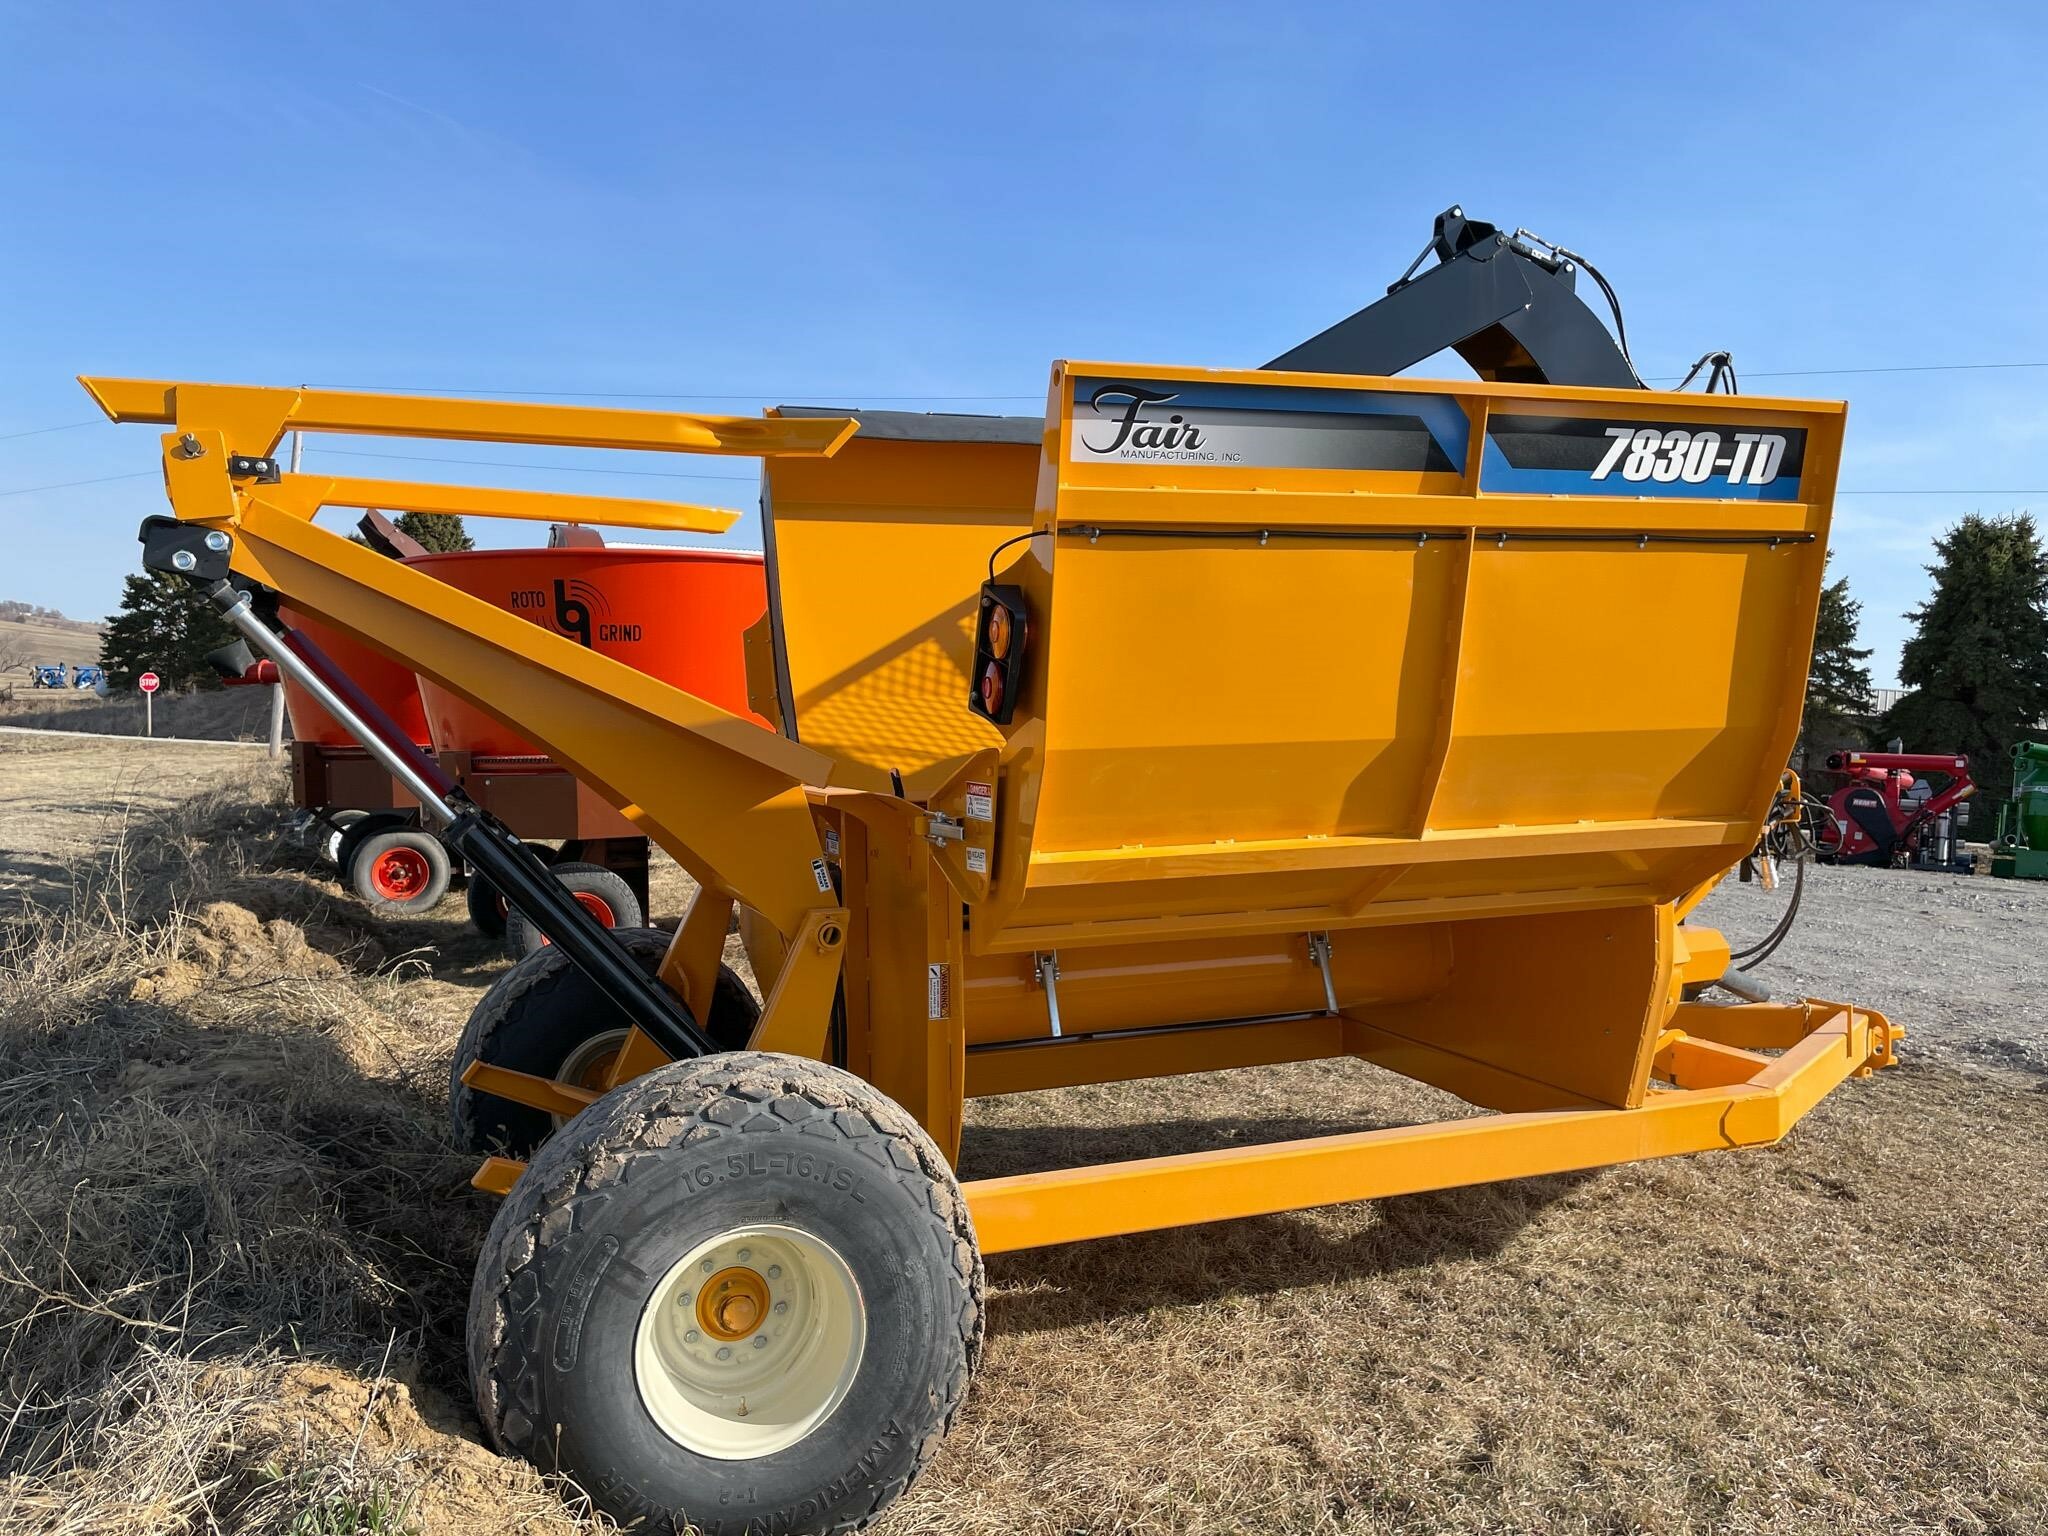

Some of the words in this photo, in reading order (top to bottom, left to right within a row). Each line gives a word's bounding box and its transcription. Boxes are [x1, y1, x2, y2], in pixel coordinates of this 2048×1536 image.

[1081, 384, 1207, 454] Fair
[1120, 450, 1218, 461] MANUFACTURING,
[1221, 453, 1245, 462] INC.
[1590, 427, 1787, 485] 7830-TD
[511, 591, 546, 608] ROTO
[599, 625, 642, 642] GRIND
[141, 678, 157, 687] STOP
[941, 973, 949, 1009] WARNING
[680, 1152, 867, 1204] 16.5L-16.1SL
